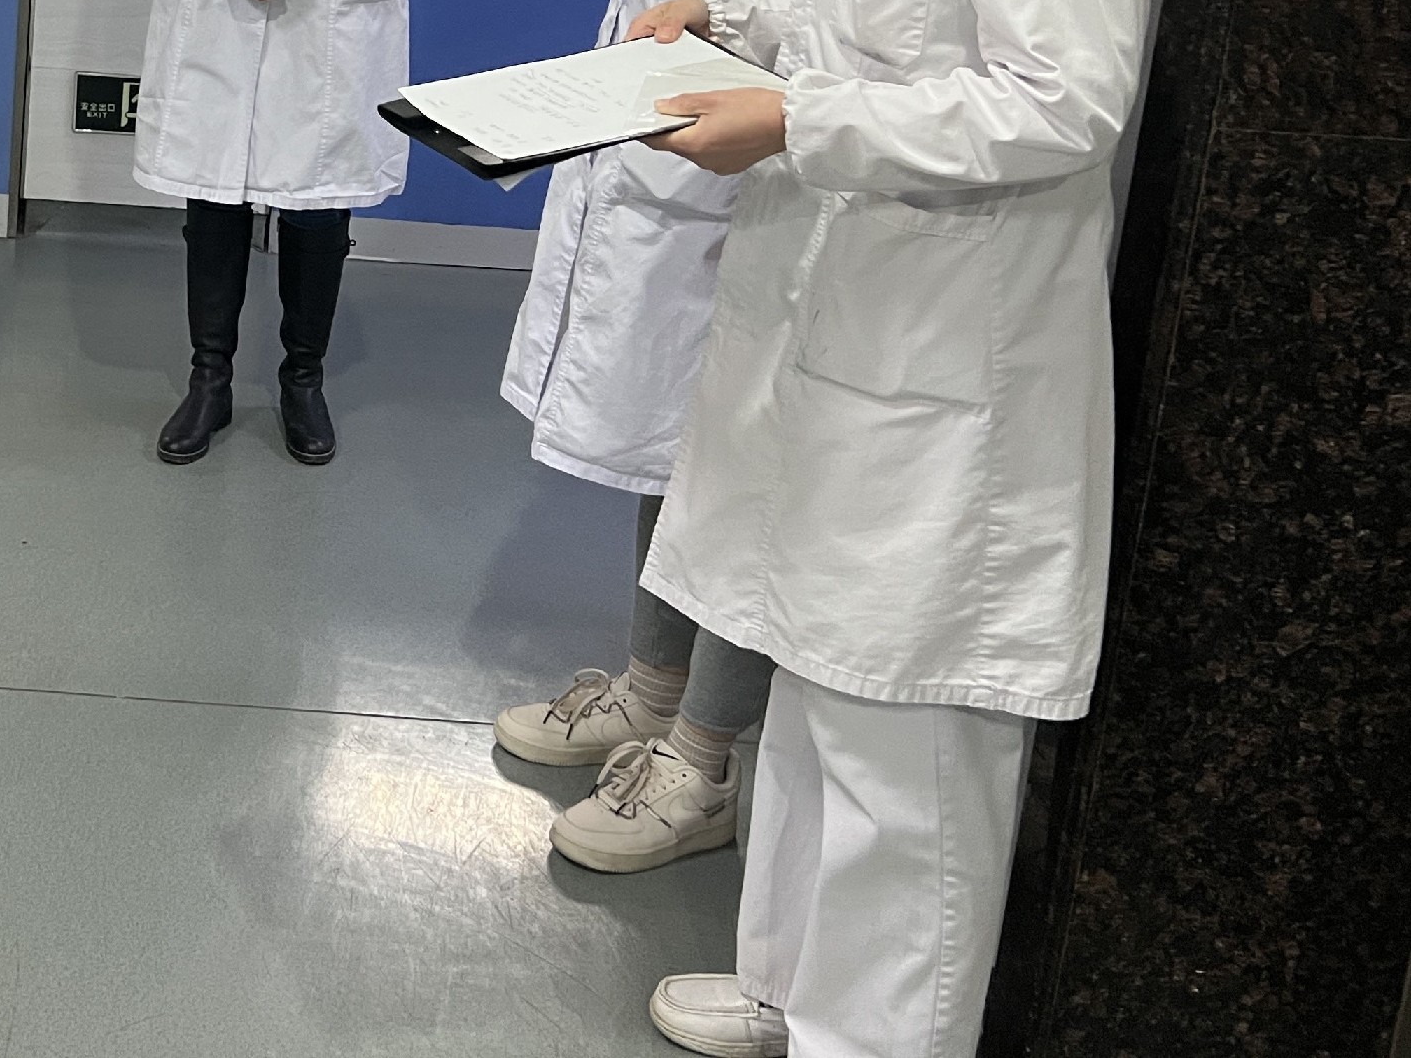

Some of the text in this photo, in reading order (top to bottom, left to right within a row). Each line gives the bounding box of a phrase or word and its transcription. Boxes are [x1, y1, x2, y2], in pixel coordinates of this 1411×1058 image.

[80, 102, 115, 112] 安全出口
[87, 111, 108, 119] EXIT
